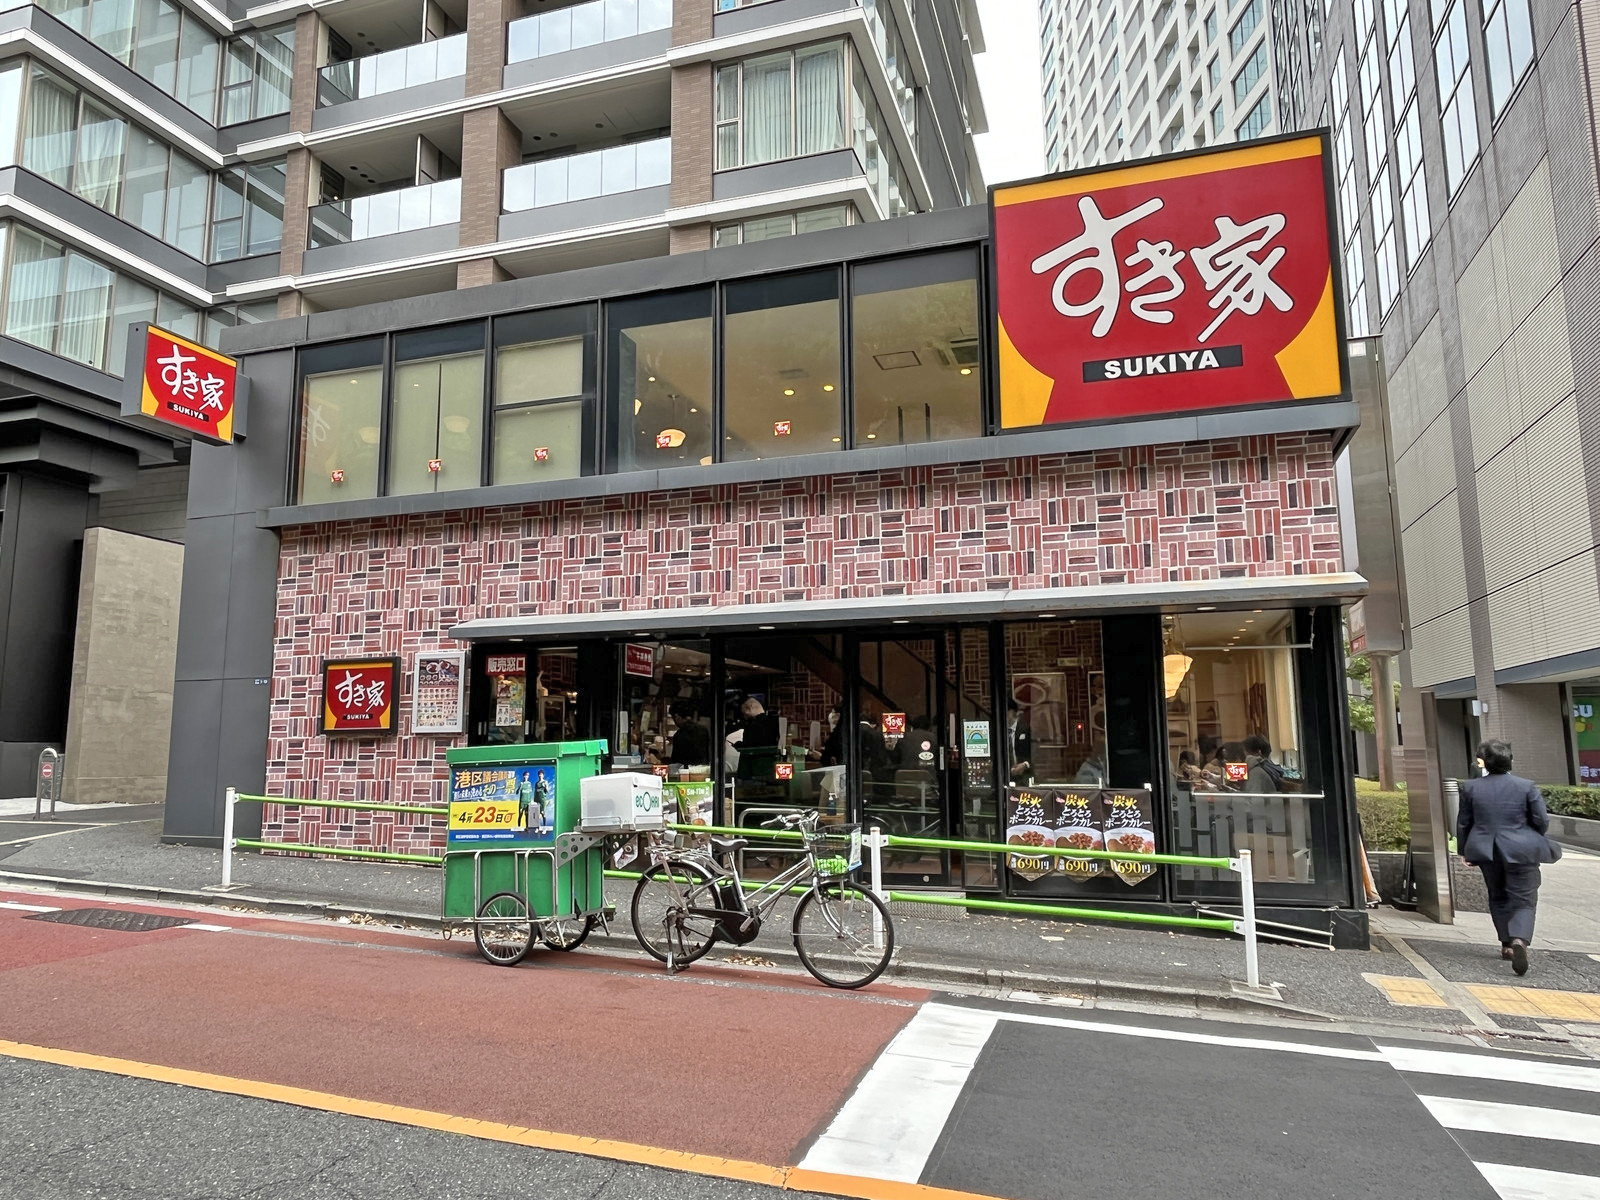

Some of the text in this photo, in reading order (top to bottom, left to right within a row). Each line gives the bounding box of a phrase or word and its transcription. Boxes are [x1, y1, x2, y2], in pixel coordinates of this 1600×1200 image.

[1031, 195, 1294, 343] すき家
[156, 344, 225, 412] すき家
[1104, 350, 1220, 378] SUKIYA
[173, 403, 204, 420] SUKIYA
[487, 657, 525, 673] 販売窓口
[334, 669, 385, 713] すき家
[346, 713, 372, 721] SUKIYA
